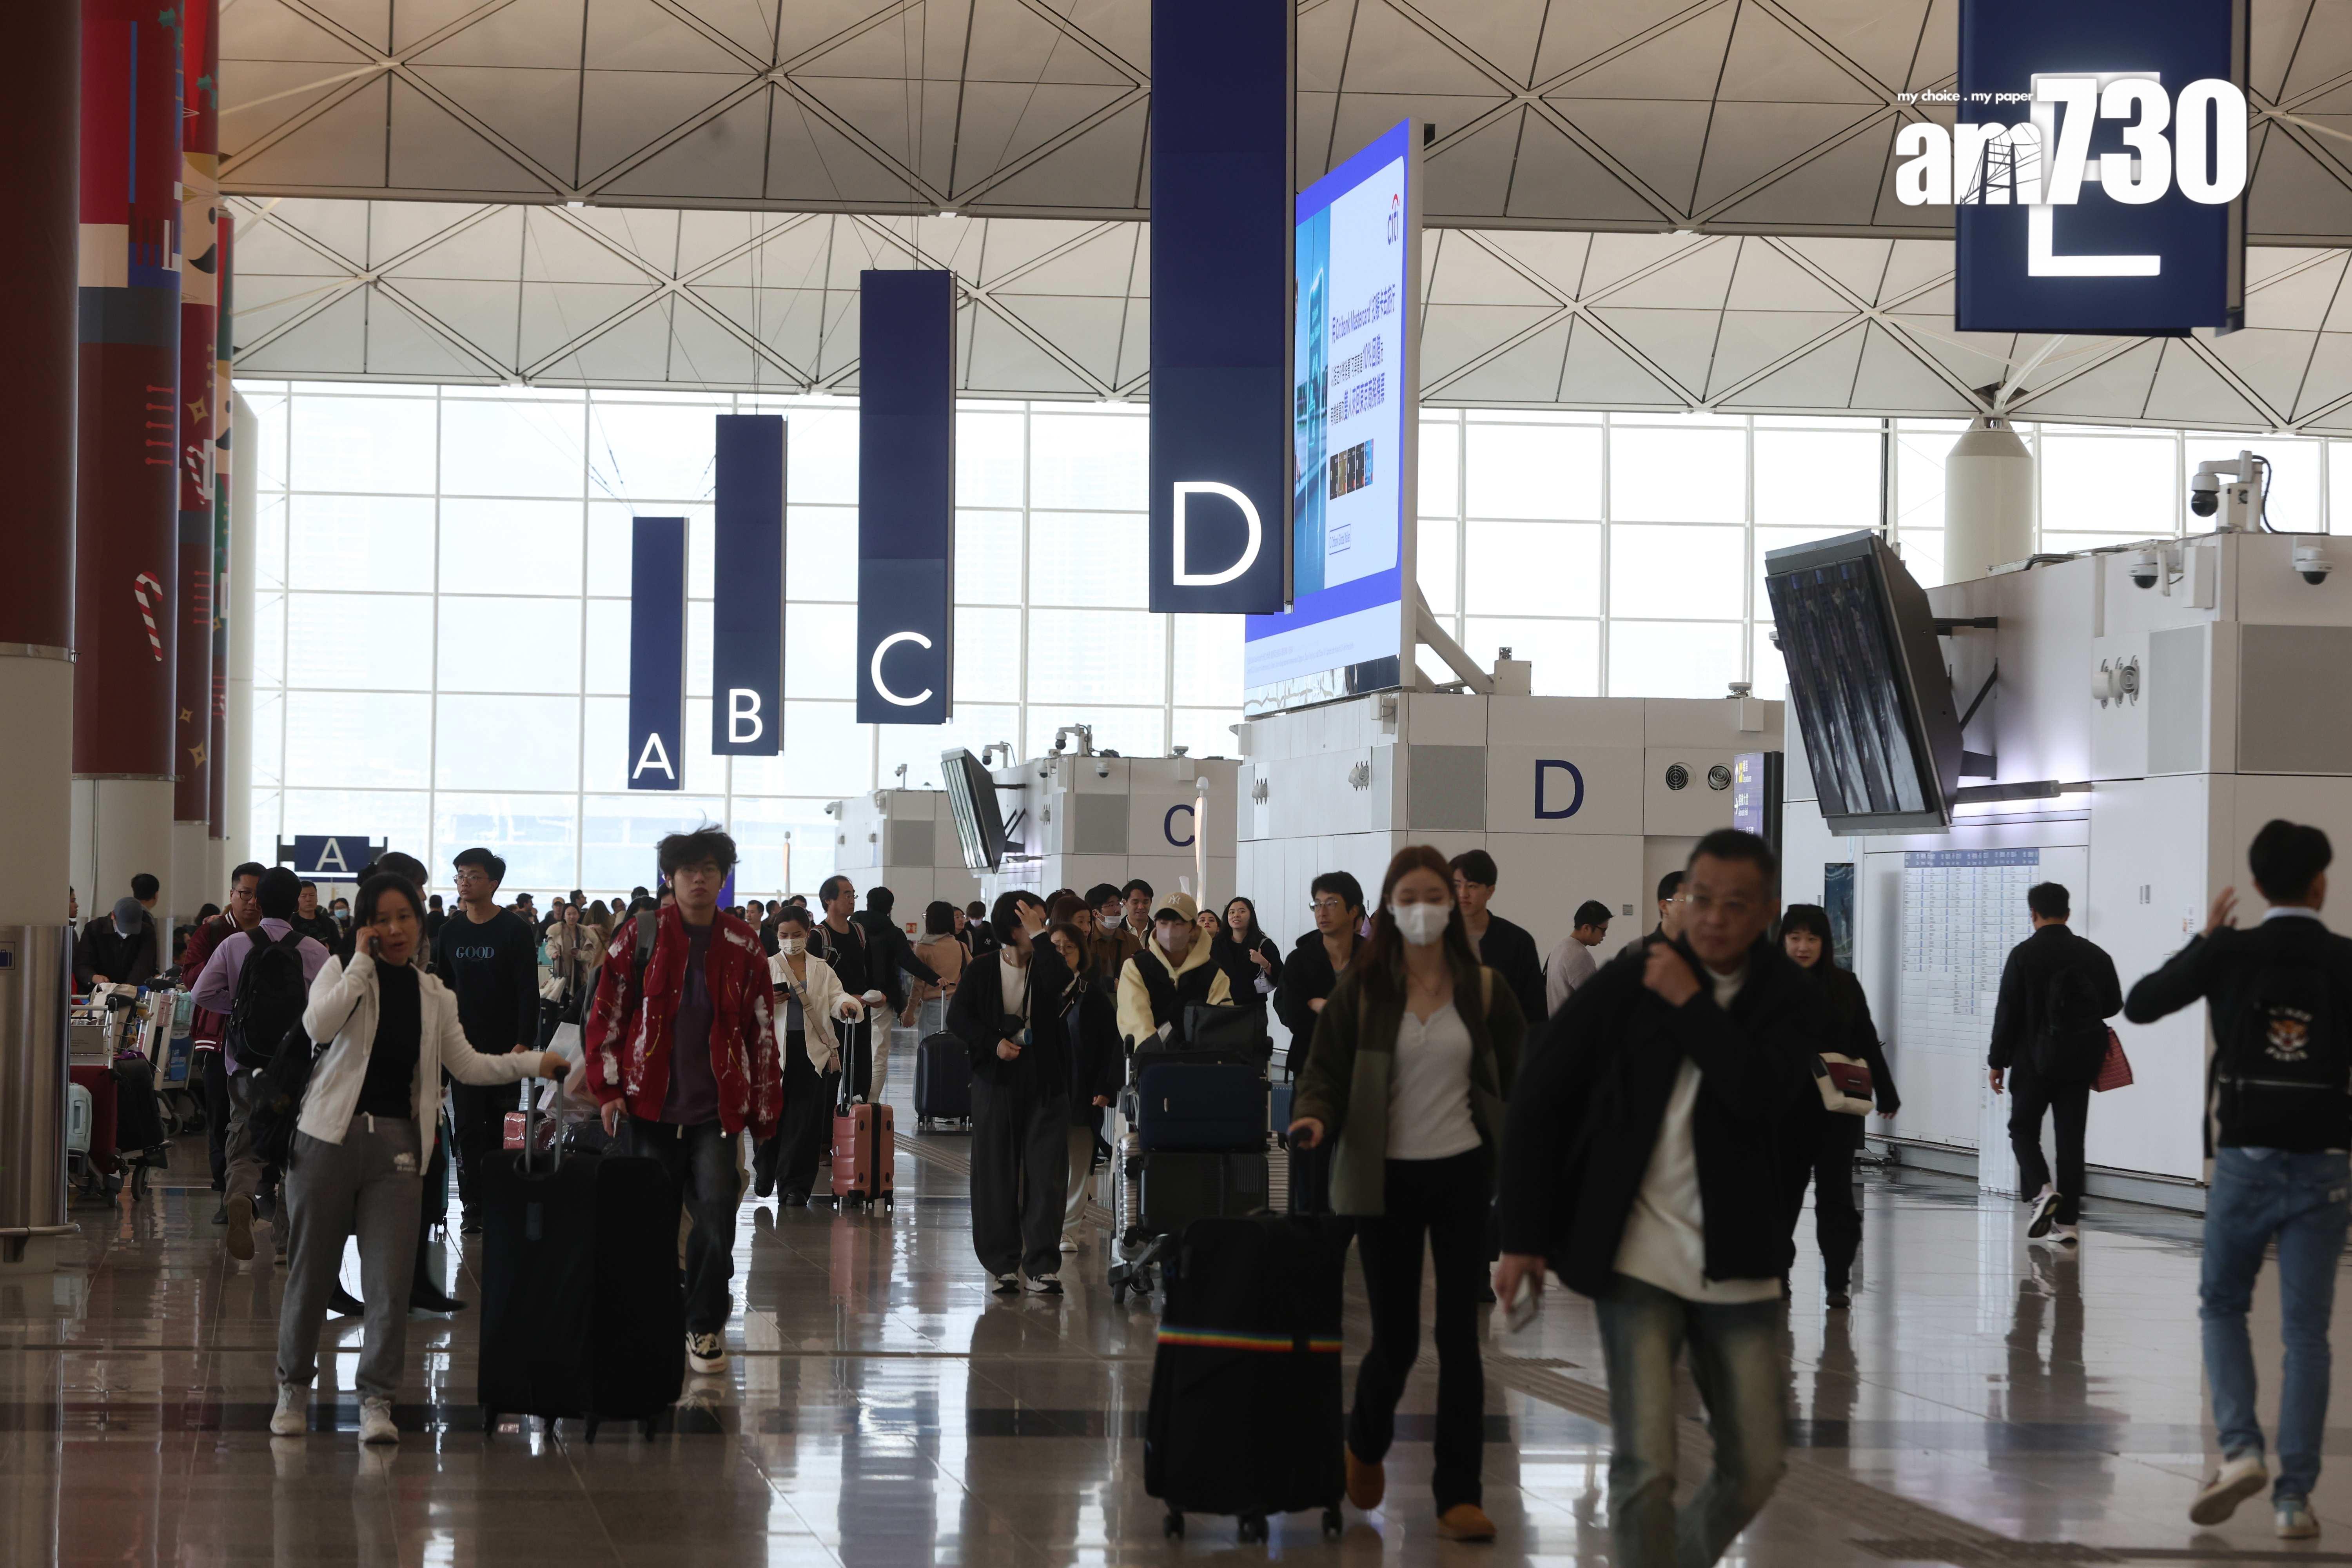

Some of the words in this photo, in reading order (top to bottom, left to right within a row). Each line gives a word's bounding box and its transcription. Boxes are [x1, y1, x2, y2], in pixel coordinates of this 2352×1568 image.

[1388, 203, 1398, 245] citi
[1173, 481, 1262, 586] D
[871, 632, 933, 706] C
[728, 688, 763, 743] B
[632, 733, 675, 780] A
[1534, 759, 1584, 819] D
[1164, 804, 1195, 847] C
[315, 837, 348, 872] A
[456, 946, 495, 958] GOOD
